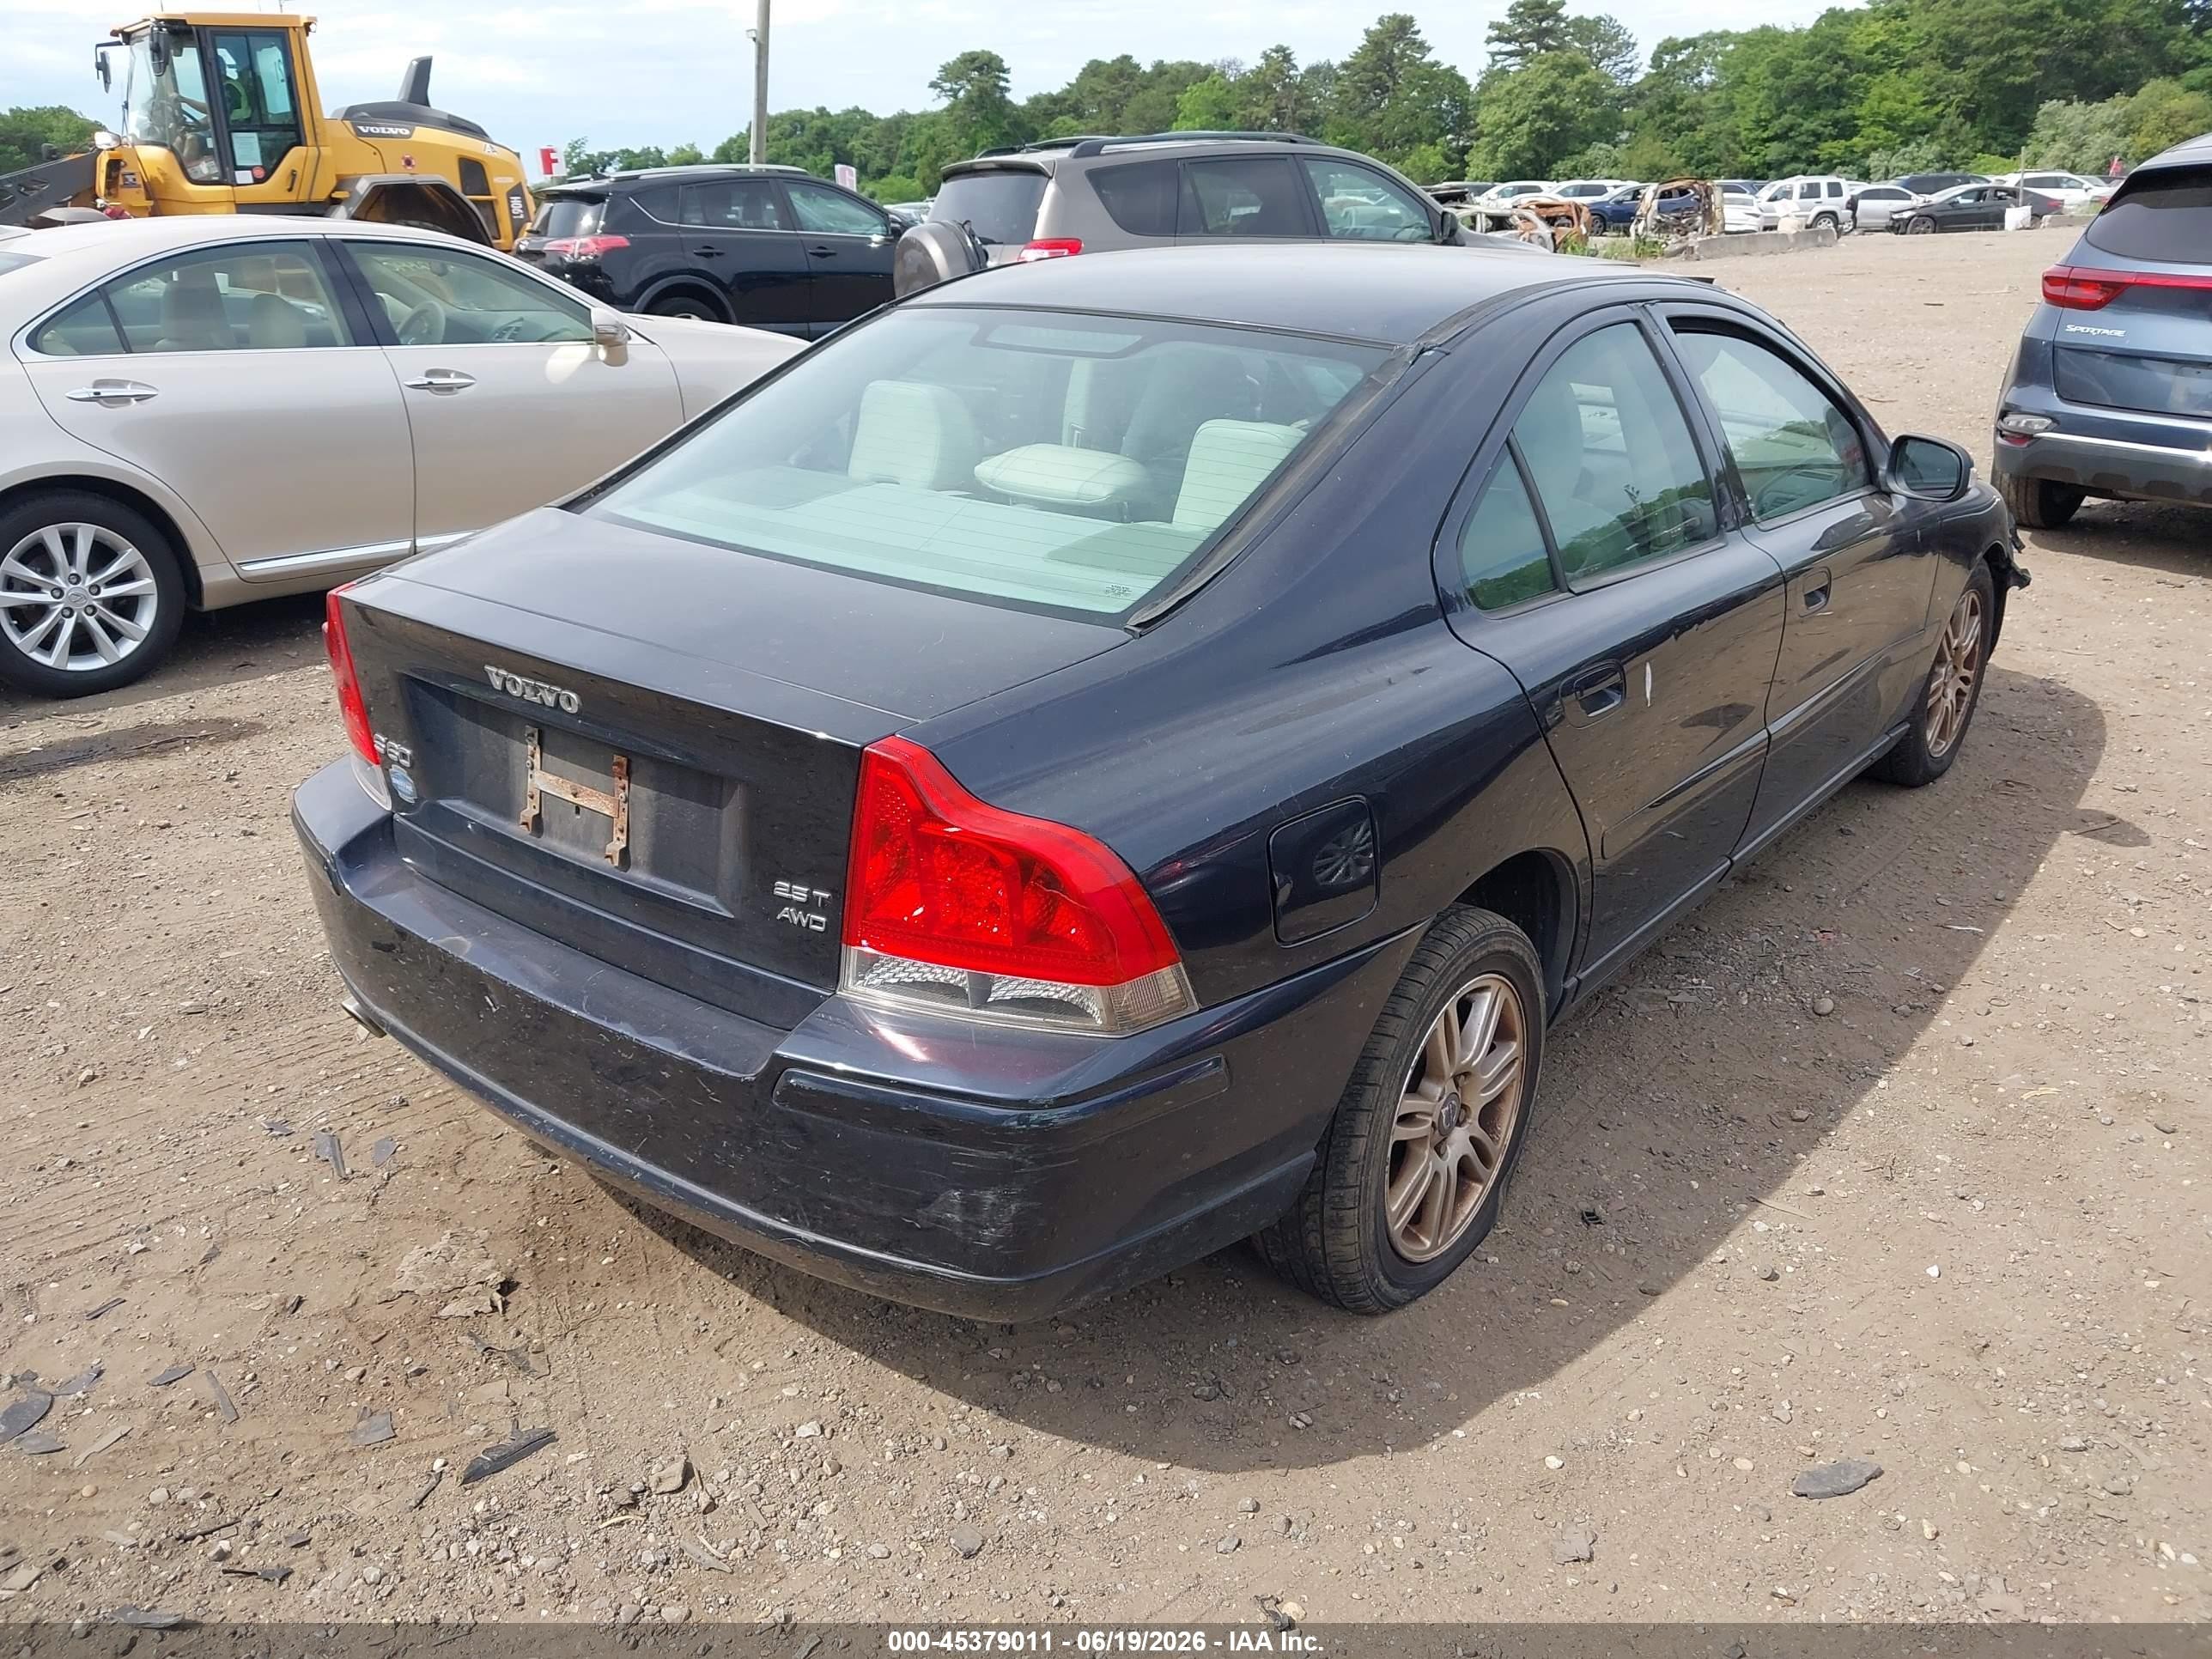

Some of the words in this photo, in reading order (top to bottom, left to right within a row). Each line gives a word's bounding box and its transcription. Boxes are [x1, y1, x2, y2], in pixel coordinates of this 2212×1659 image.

[357, 125, 411, 135] VOLVO
[539, 148, 558, 175] F
[509, 196, 525, 219] L90H
[2065, 324, 2127, 337] SPORTAGE
[483, 665, 582, 714] VOLVO
[373, 733, 412, 768] S60
[812, 890, 831, 908] T
[776, 907, 826, 933] AWD
